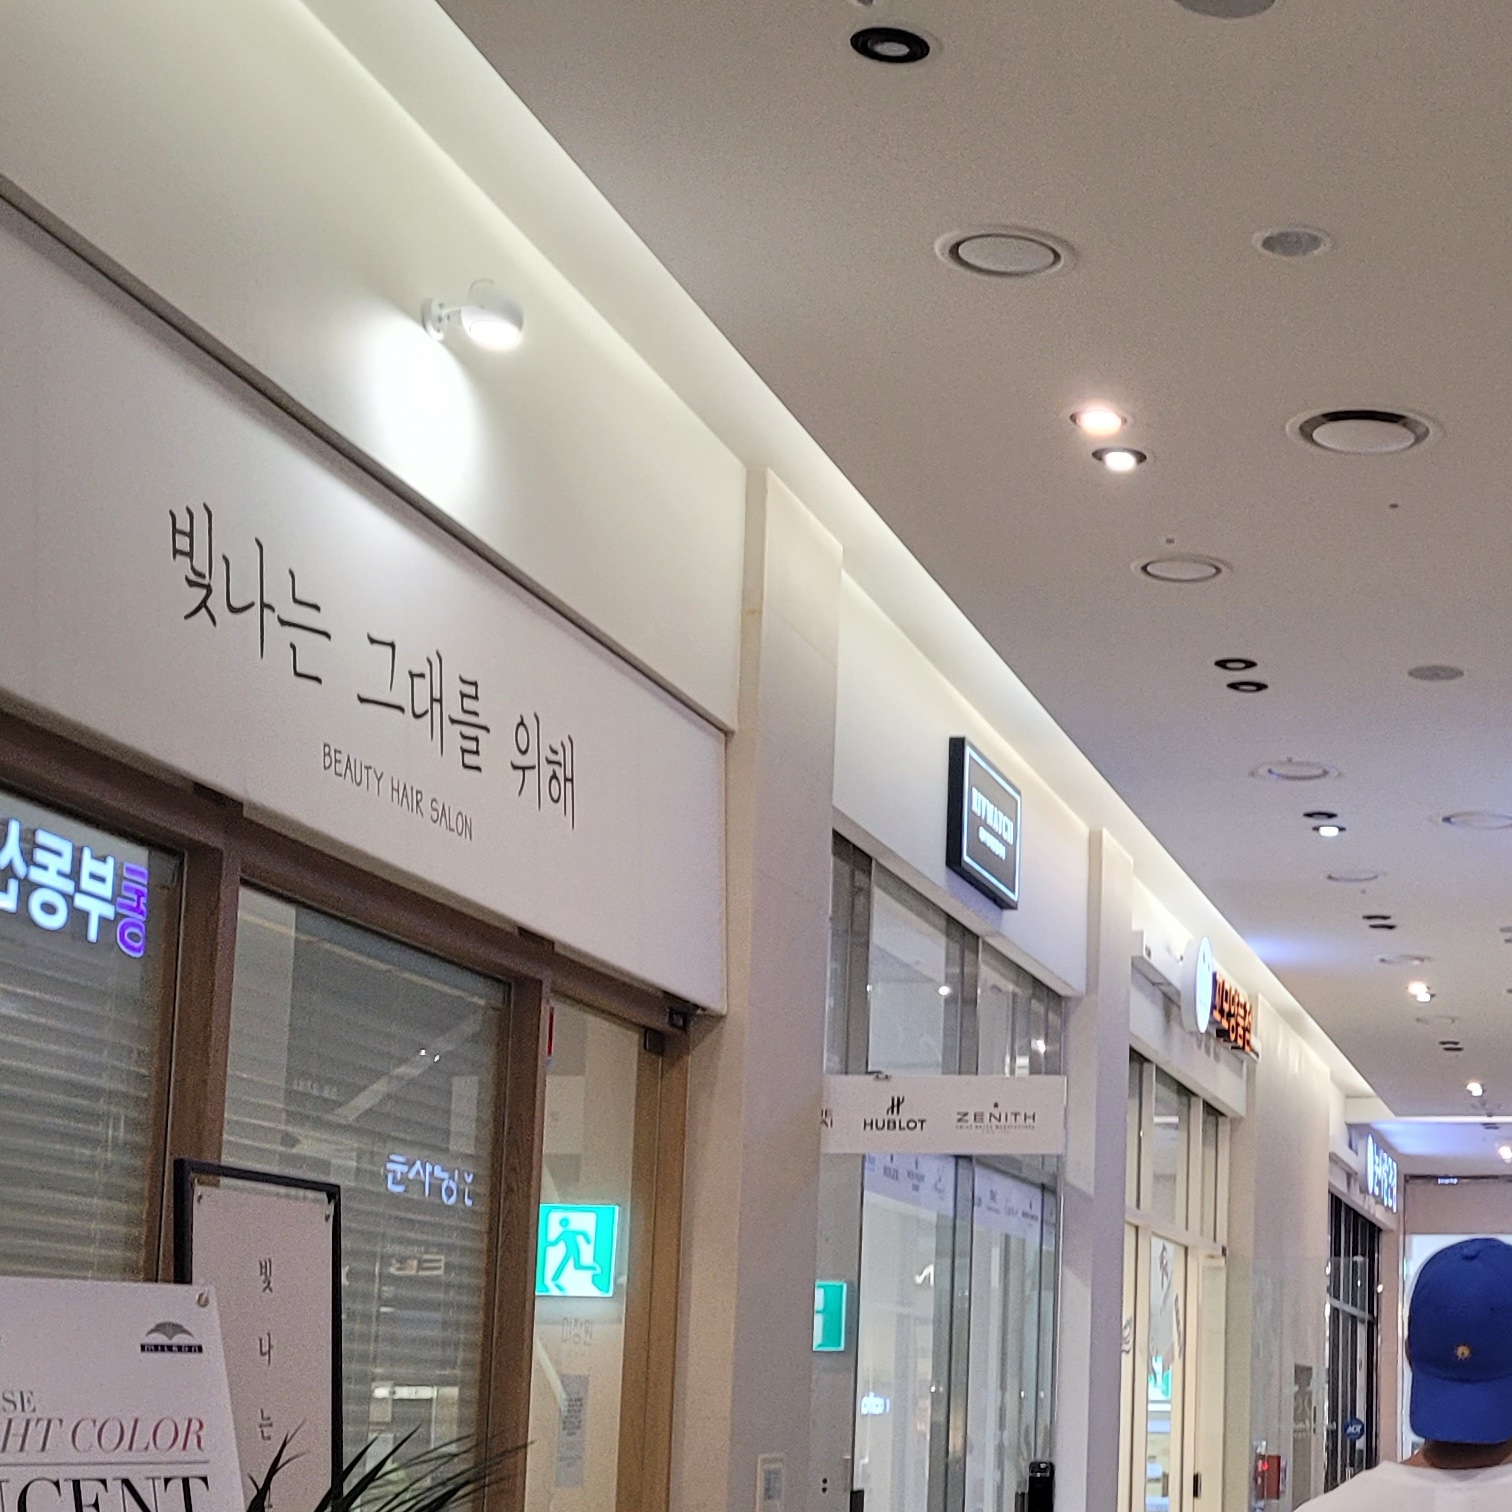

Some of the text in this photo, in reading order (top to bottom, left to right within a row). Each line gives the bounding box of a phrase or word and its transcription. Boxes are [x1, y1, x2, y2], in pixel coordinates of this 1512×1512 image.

[169, 503, 576, 830] 빛나는 그대를 위해
[323, 742, 473, 841] BEAUTY HAIR SALON
[863, 1111, 1036, 1132] HUBLOT ZENITH
[71, 1416, 206, 1453] COLOR
